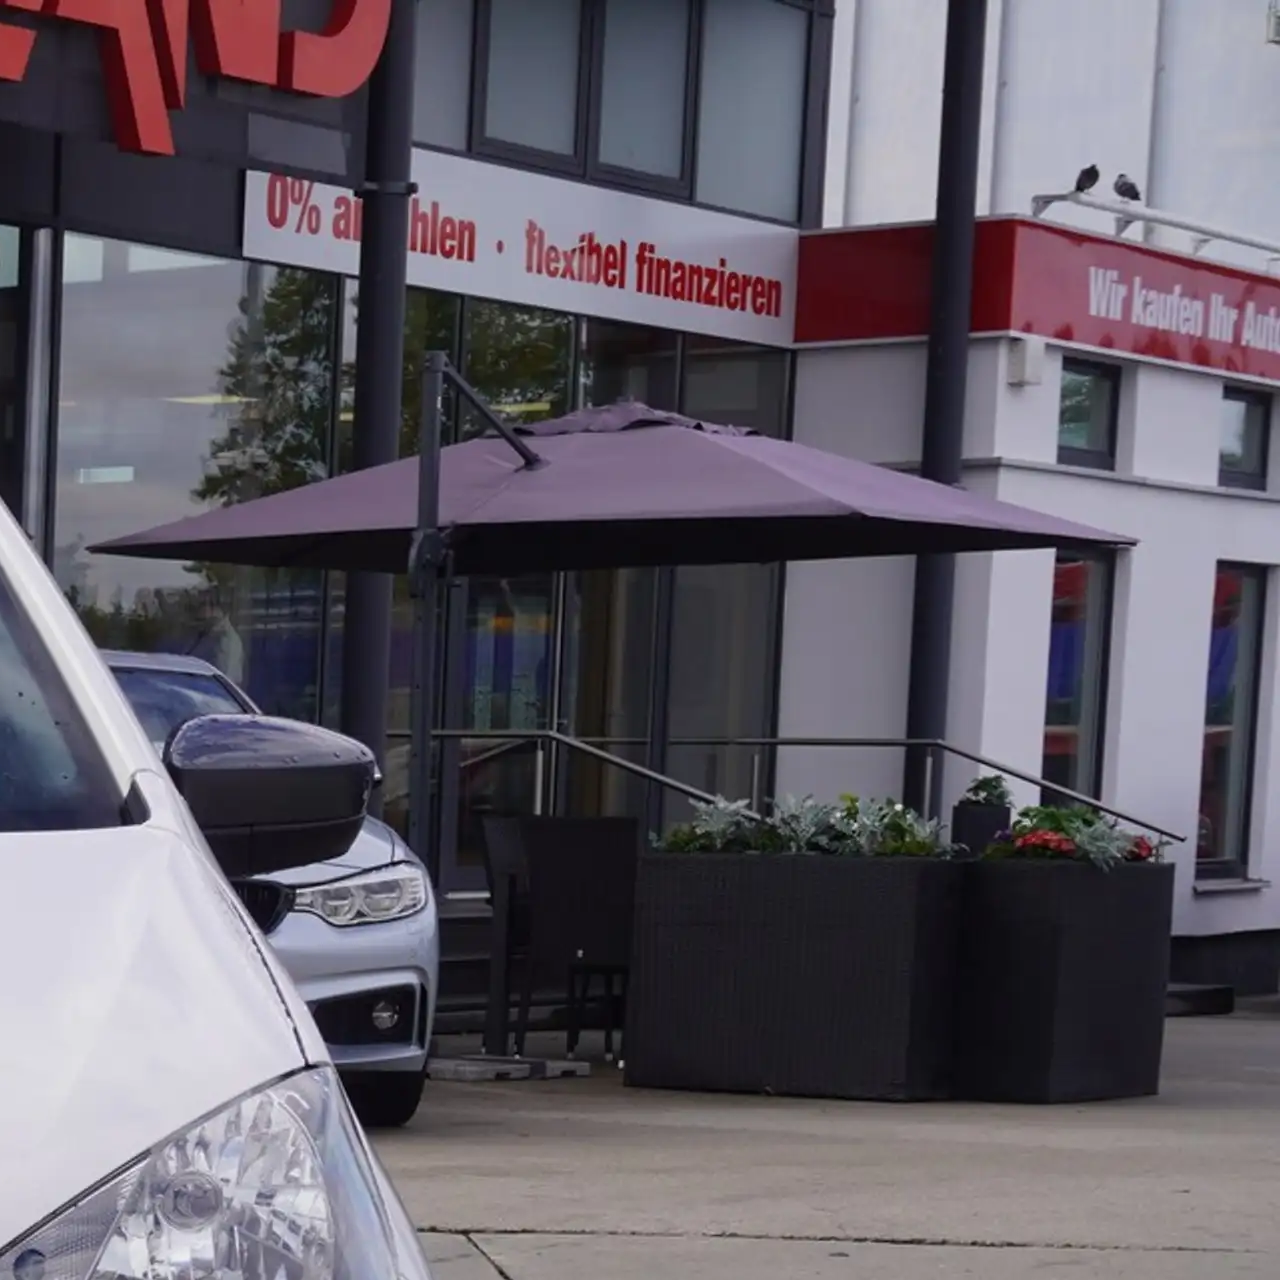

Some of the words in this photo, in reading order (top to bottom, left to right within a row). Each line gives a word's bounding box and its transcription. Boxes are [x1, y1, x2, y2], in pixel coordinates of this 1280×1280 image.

[266, 171, 321, 235] 0%
[525, 219, 627, 289] flexibel
[636, 242, 782, 318] finanzieren
[1089, 266, 1128, 321] Wir
[1131, 276, 1205, 337] kaufen
[1208, 293, 1238, 344] Ihr
